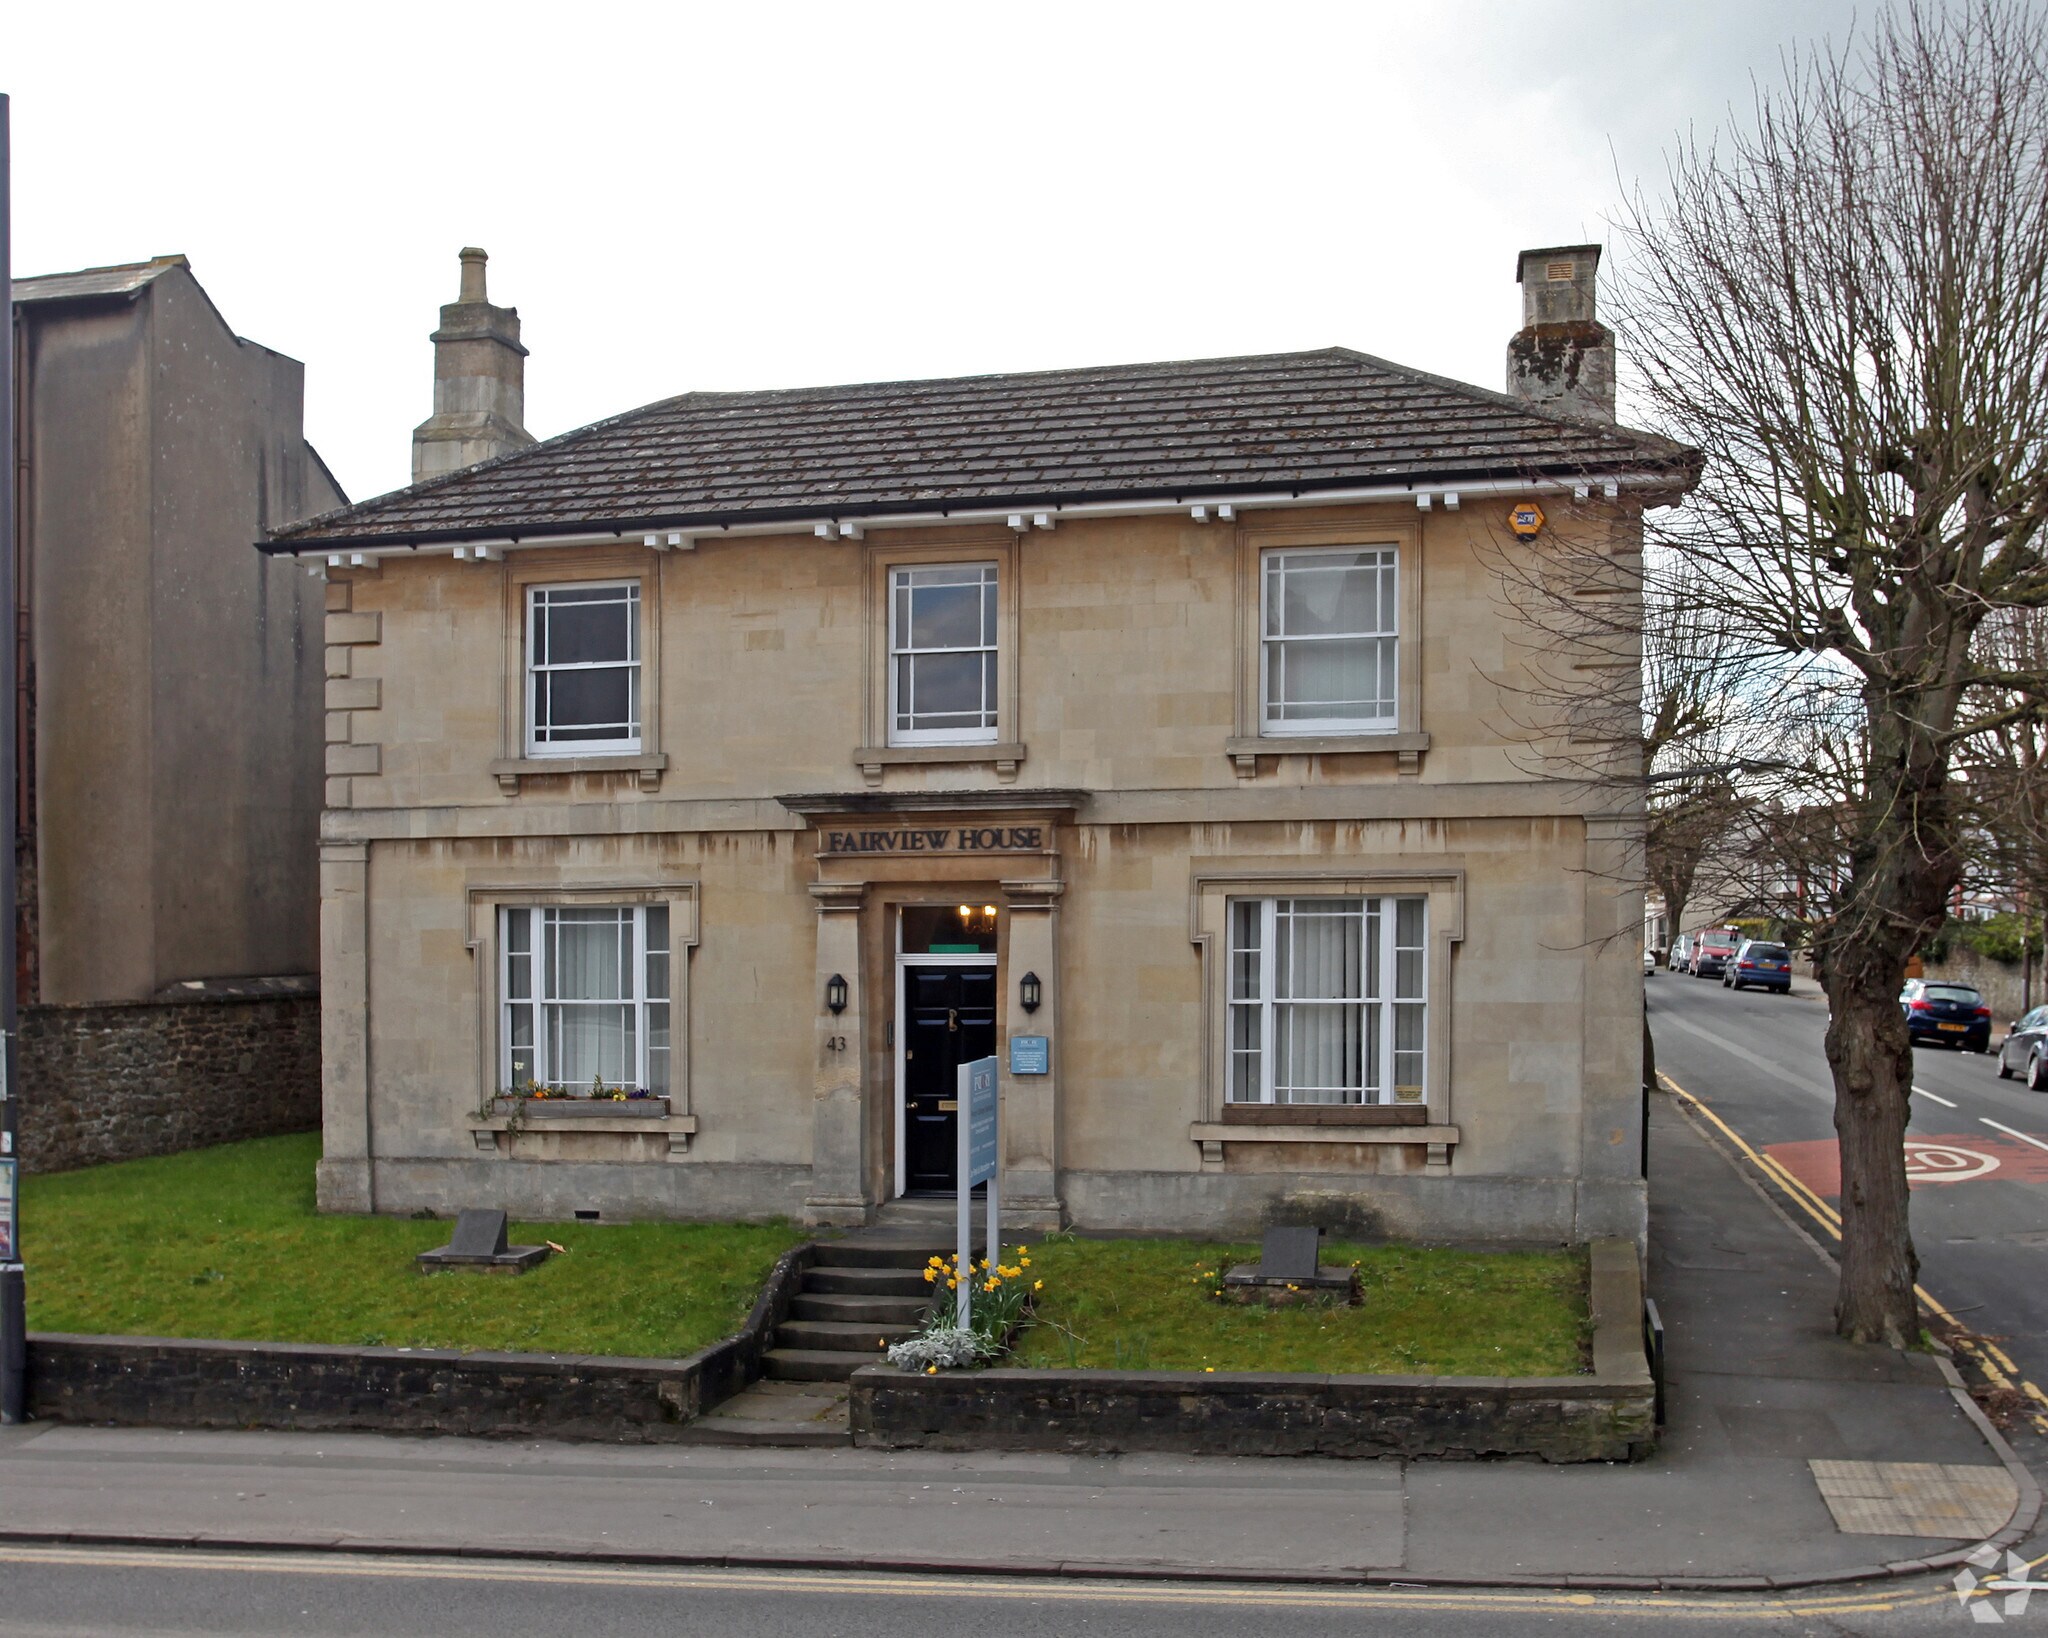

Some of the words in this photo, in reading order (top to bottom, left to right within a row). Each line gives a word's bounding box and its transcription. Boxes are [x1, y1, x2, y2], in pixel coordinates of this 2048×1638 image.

[829, 831, 951, 850] FAIRVIEW
[958, 828, 1042, 849] HOUSE
[826, 1036, 846, 1051] 43
